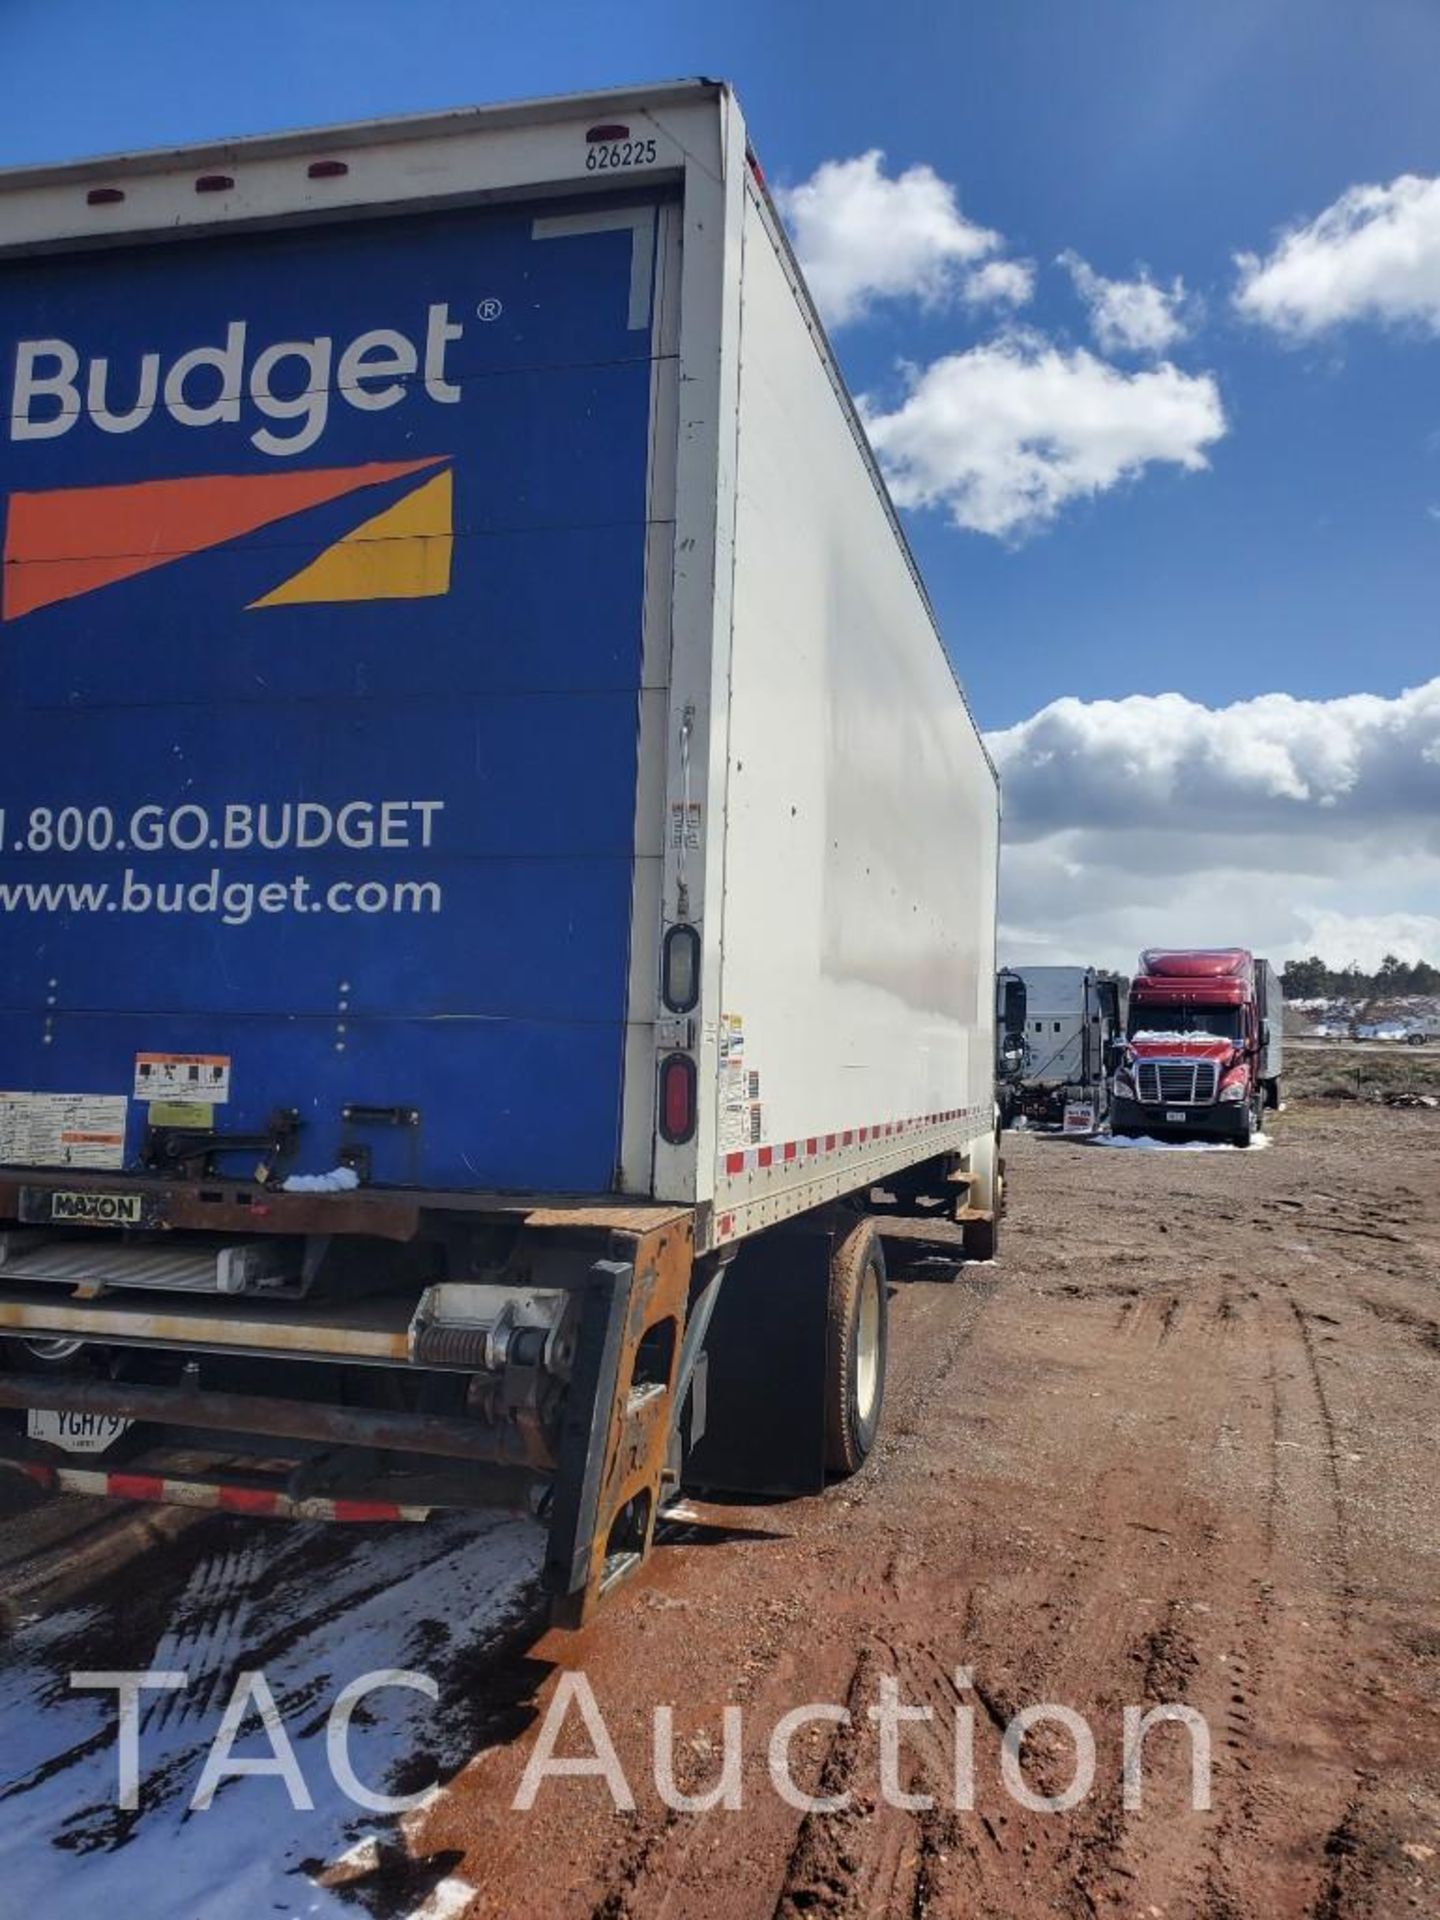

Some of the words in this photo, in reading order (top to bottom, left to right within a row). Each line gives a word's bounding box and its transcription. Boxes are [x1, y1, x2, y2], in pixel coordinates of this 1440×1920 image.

[585, 139, 657, 170] 626225
[11, 303, 463, 456] Budget
[0, 868, 441, 924] www.budget.com
[54, 1196, 134, 1218] MAXON
